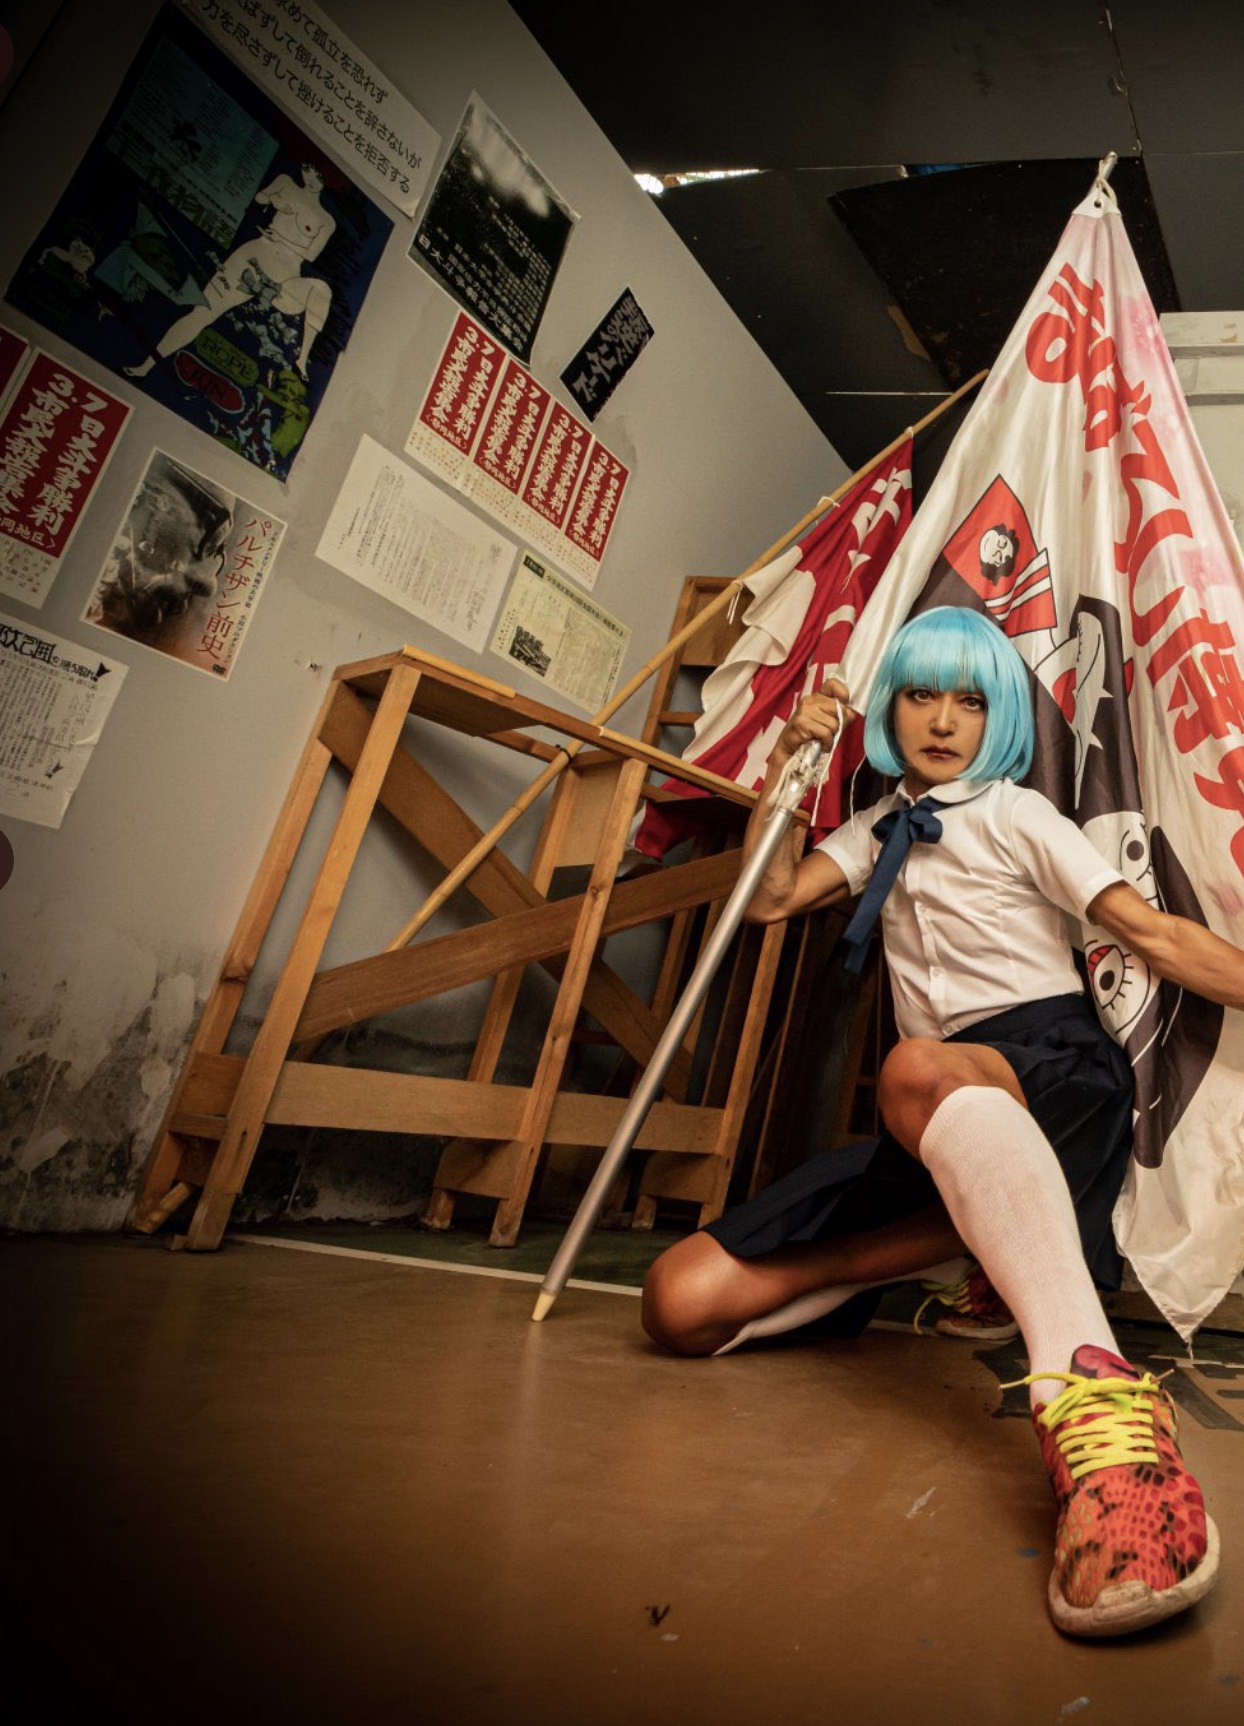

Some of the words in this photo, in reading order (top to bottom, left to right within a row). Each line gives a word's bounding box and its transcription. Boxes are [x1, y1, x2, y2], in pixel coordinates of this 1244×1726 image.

[463, 324, 495, 358] 3.7
[48, 371, 109, 418] 3.7
[513, 369, 541, 402] 3.7
[558, 411, 583, 441] 3.7
[30, 415, 105, 538] 日大斗争勝利
[597, 450, 621, 477] 3.7
[197, 518, 273, 660] パルチザン前史
